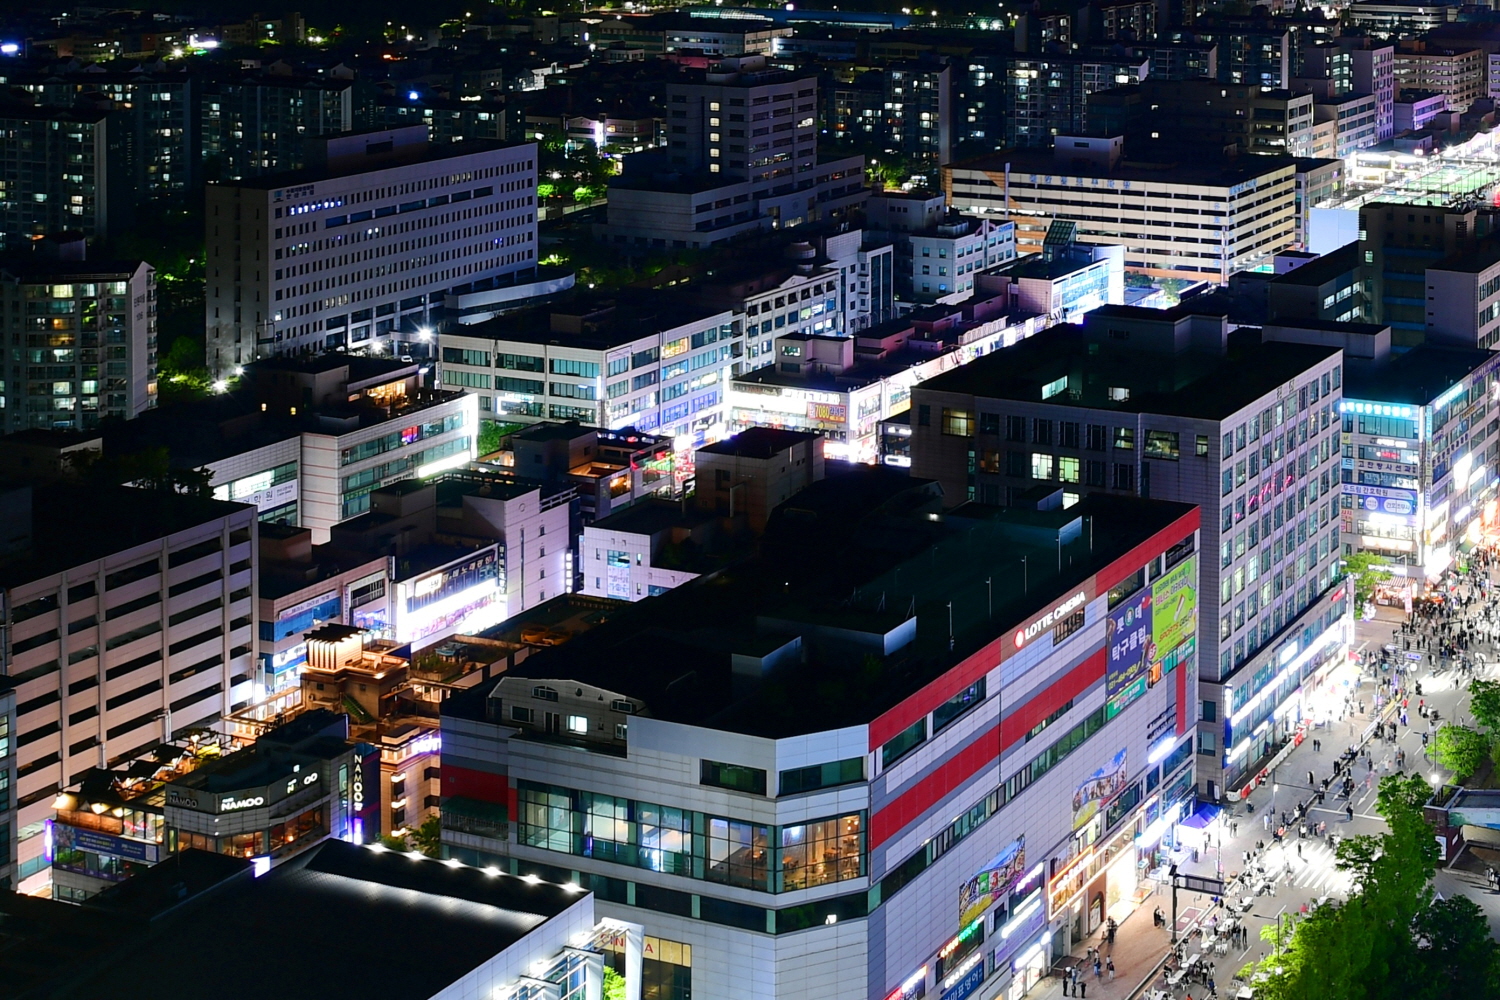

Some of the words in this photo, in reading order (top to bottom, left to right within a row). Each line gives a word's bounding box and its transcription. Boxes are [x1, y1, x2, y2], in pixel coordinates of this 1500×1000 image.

[1024, 612, 1053, 641] LOTTE
[1053, 591, 1086, 620] CINEMA
[221, 796, 264, 811] NAMOO
[600, 933, 654, 954] CINA
